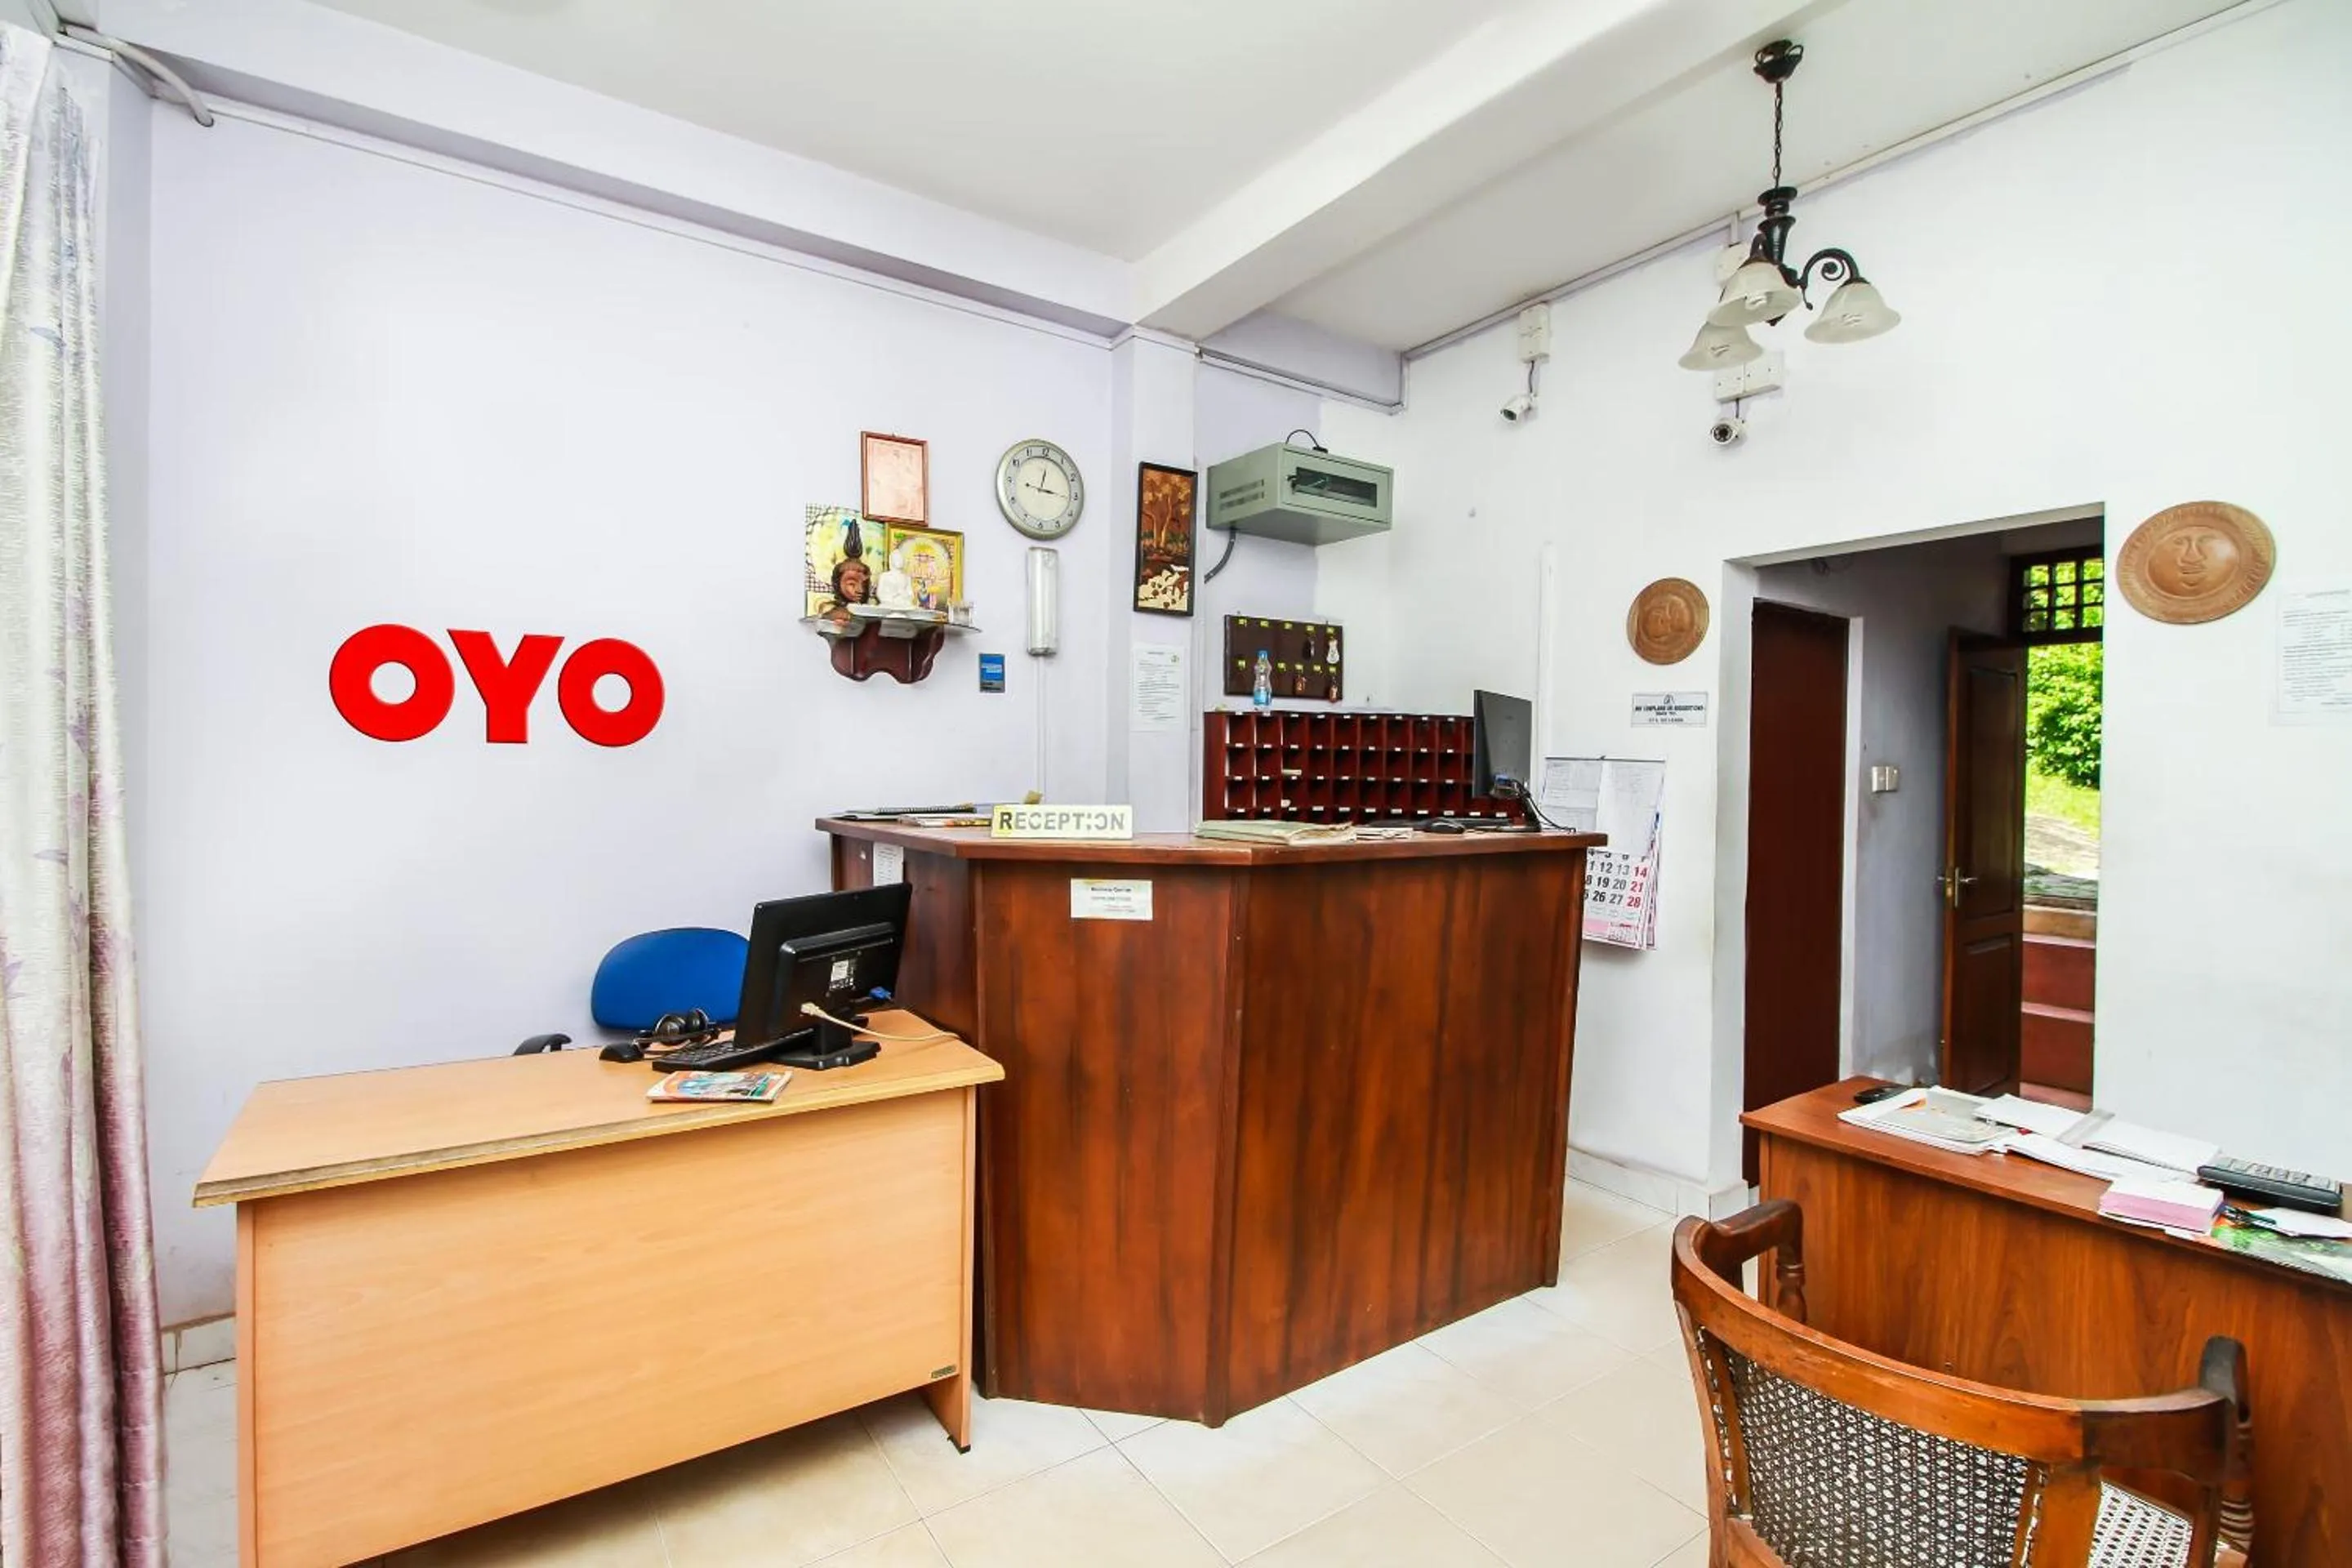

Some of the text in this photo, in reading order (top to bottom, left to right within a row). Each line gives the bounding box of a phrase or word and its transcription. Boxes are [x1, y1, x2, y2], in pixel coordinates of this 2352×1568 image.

[328, 624, 665, 747] OYO
[1600, 862, 1613, 874] 12
[1616, 864, 1629, 875] 13
[1634, 866, 1647, 878] 14
[1597, 876, 1610, 889] 19
[1612, 879, 1627, 890] 20
[1630, 880, 1643, 893] 21
[1592, 889, 1606, 902] 26
[1609, 893, 1624, 906] 27
[1627, 896, 1642, 908] 28
